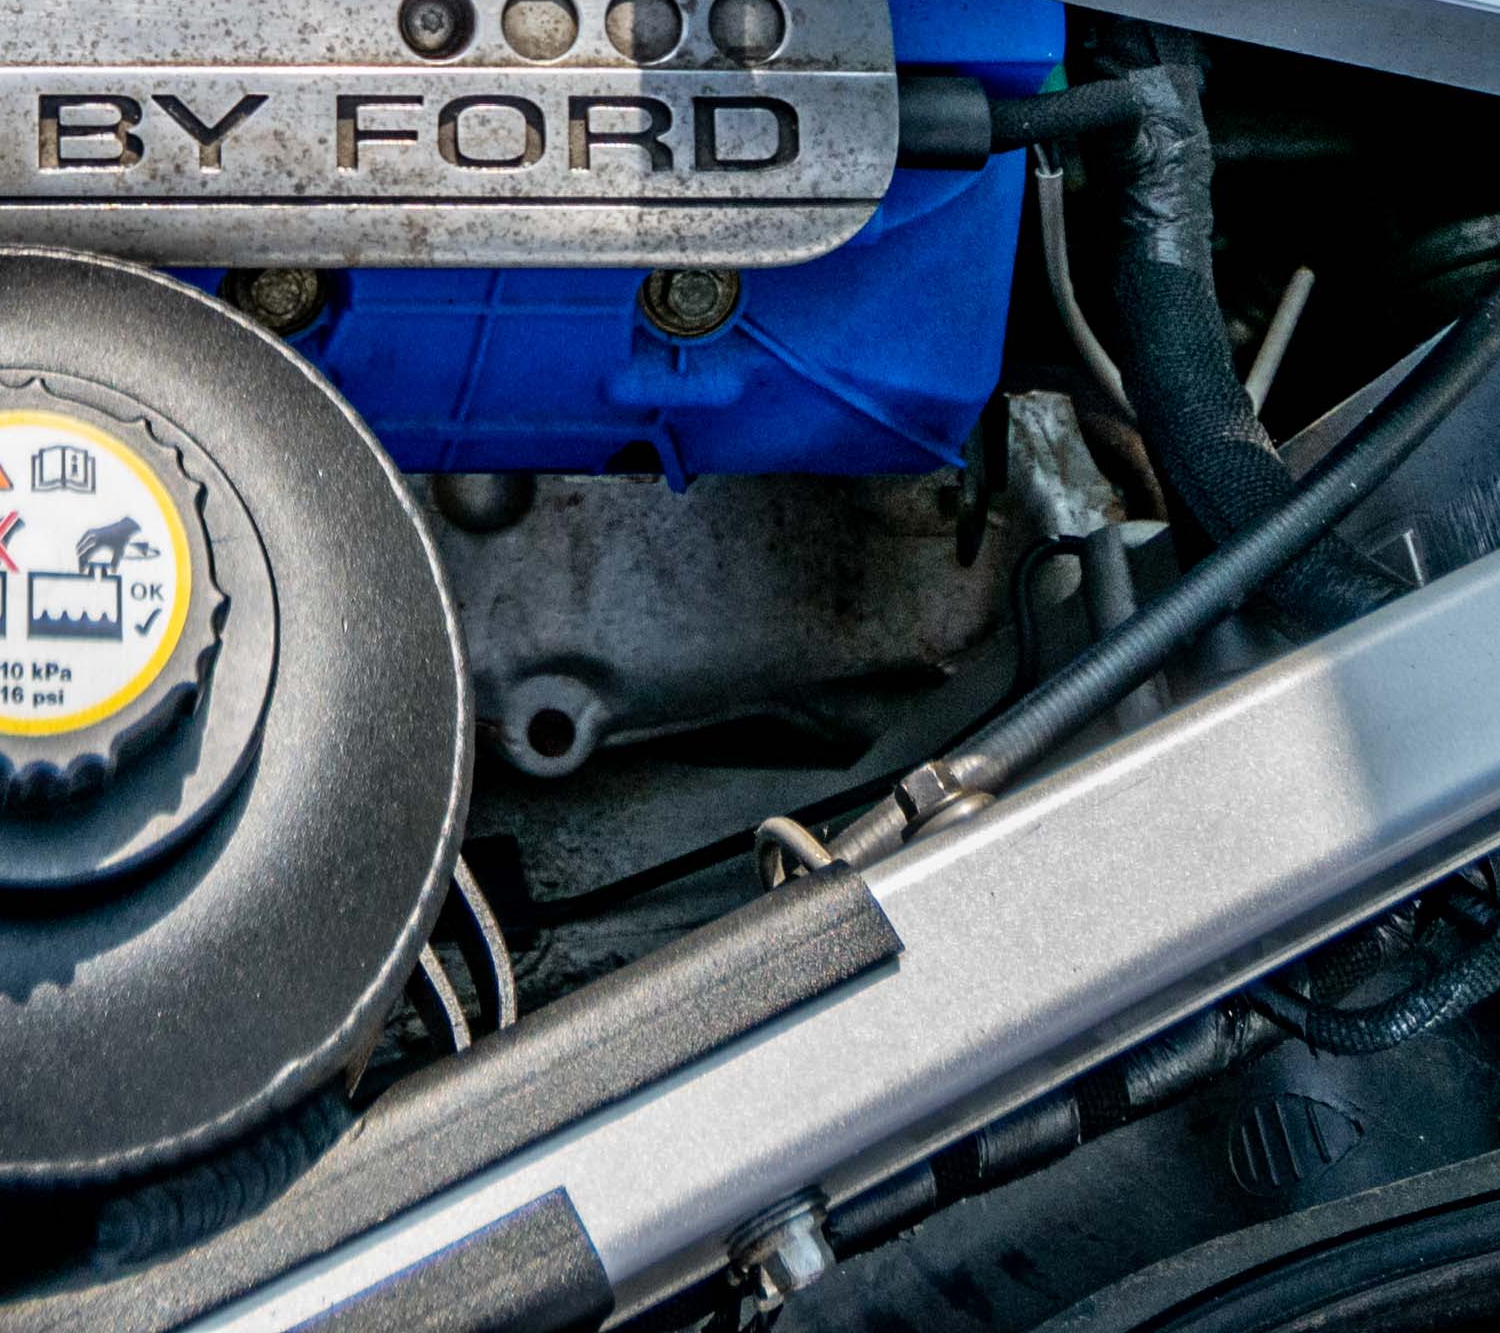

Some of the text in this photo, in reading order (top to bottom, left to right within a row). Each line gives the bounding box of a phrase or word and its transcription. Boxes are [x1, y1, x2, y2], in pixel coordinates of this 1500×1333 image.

[36, 93, 271, 174] BY
[334, 93, 803, 174] FORD
[129, 582, 166, 602] OK
[31, 661, 73, 683] kPa
[0, 685, 65, 708] 16 psi
